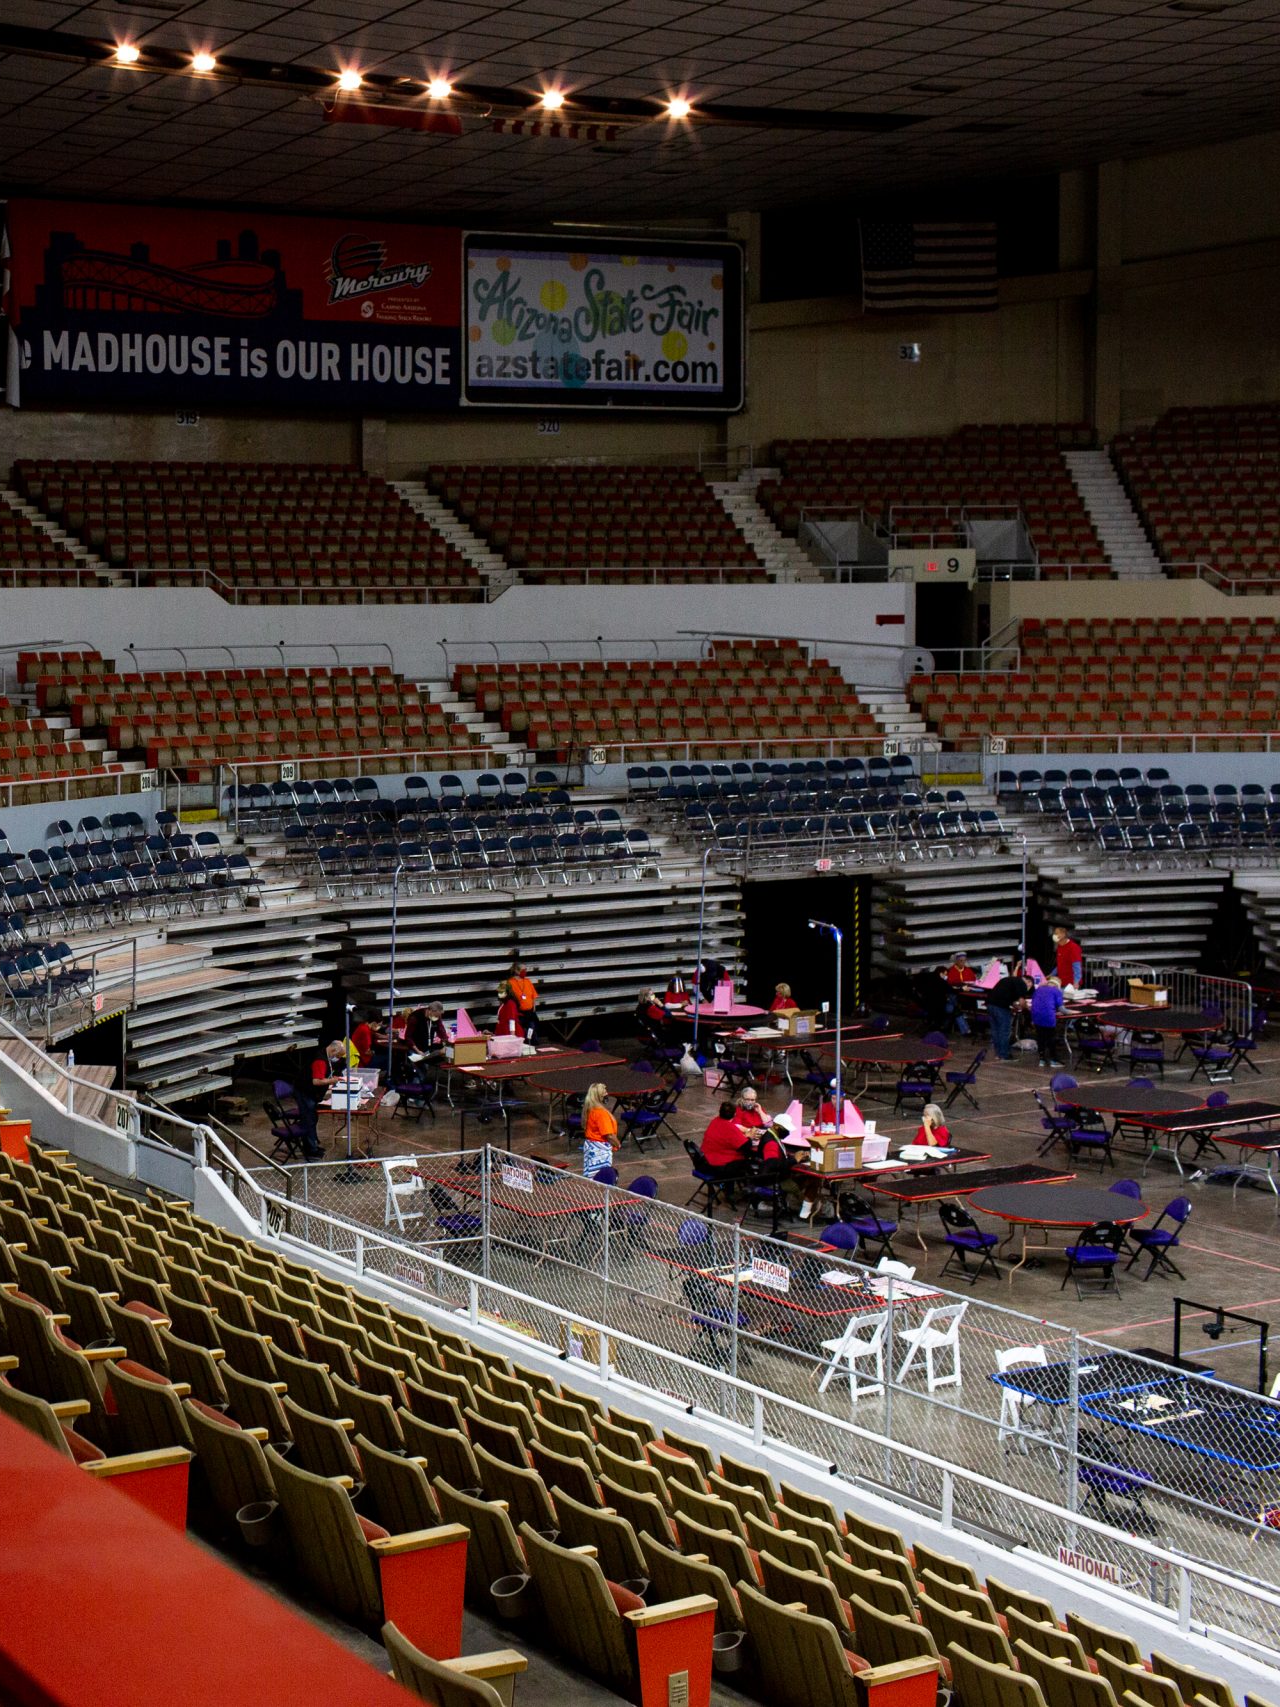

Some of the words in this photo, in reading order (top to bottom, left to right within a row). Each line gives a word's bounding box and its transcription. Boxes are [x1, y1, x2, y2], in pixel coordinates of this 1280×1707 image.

[333, 264, 431, 299] Mercury
[473, 270, 572, 343] Arizona
[574, 268, 645, 343] State
[640, 284, 720, 337] Fair
[43, 329, 231, 376] MADHOUSE
[240, 339, 267, 378] is
[275, 338, 341, 382] OUR
[349, 343, 451, 386] HOUSE
[476, 350, 719, 384] azstatefair.com
[176, 410, 197, 425] 319
[947, 557, 959, 573] 9
[593, 750, 605, 762] 210
[885, 743, 897, 754] 210
[282, 766, 294, 778] 209
[753, 1259, 787, 1280] NATIONAL
[1059, 1547, 1120, 1585] NATIONAL
